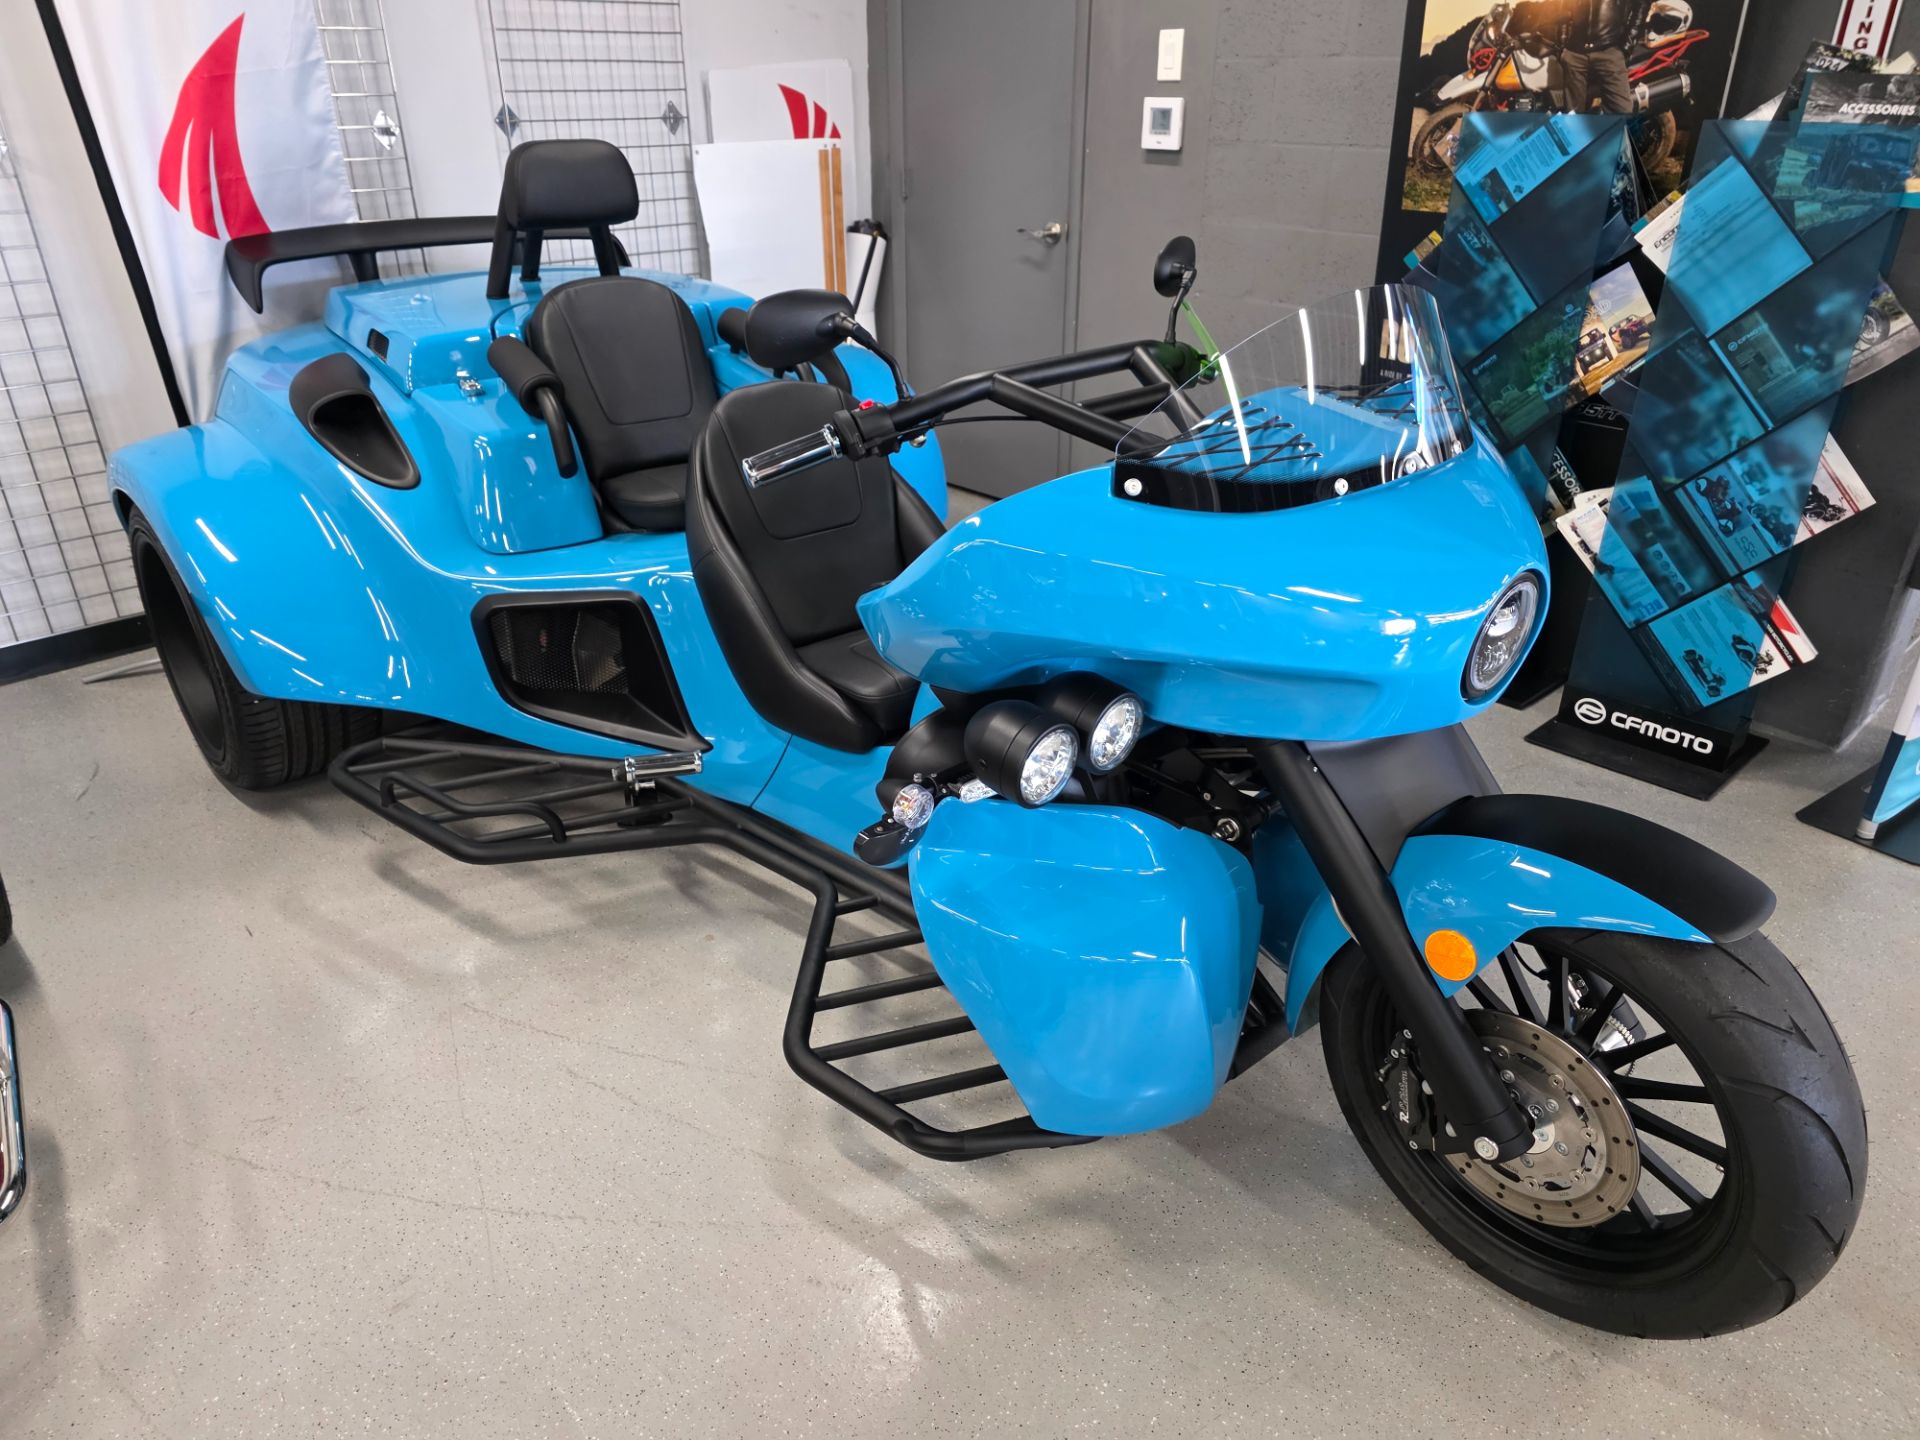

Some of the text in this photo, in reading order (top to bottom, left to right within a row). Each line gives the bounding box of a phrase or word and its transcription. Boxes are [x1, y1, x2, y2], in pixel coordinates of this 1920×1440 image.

[1853, 0, 1874, 49] ING
[1838, 103, 1917, 116] ACCESSORIES
[1610, 711, 1714, 755] CFMOTO
